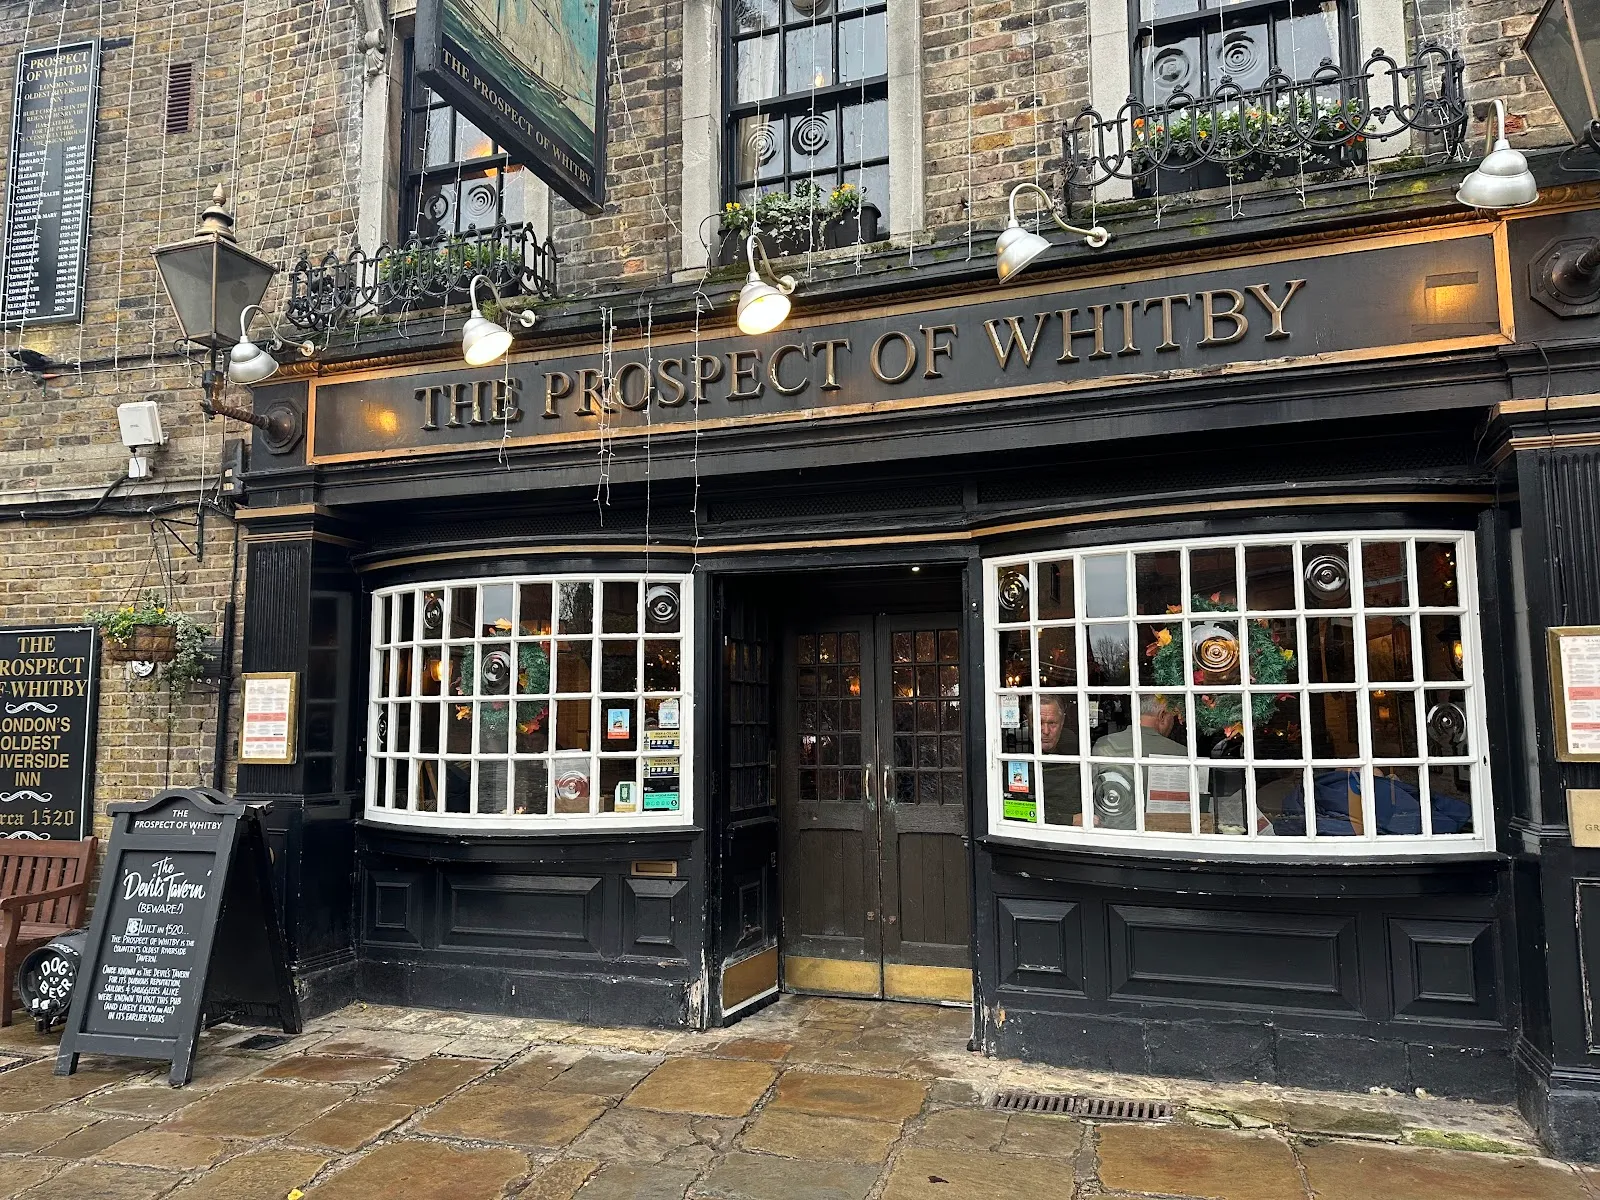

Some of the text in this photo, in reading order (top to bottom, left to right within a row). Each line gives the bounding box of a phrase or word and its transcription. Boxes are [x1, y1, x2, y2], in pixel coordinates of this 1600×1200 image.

[30, 52, 88, 70] PROSPECT
[27, 63, 90, 82] OF WHITBY
[24, 91, 50, 100] OLDEST
[442, 48, 592, 187] THE PROSPECT OF WHITBY
[414, 278, 1308, 432] THE PROSPECT OF WHITBY
[17, 636, 56, 654] THE
[0, 657, 84, 676] ROSPECT
[10, 680, 88, 698] WHITBY
[0, 717, 70, 732] ONDON'S
[0, 736, 61, 750] OLDEST
[15, 772, 40, 786] INN
[31, 808, 75, 826] 1520
[172, 810, 188, 818] THE
[134, 820, 222, 830] PROSPECT OF WHITBY
[152, 856, 174, 876] The
[138, 902, 184, 914] (BEWARE!)
[122, 934, 148, 944] PROSPECT
[114, 945, 140, 953] COUNTRY'S
[160, 948, 186, 956] RIVERSIDE
[41, 957, 69, 976] DOG
[118, 966, 136, 976] KNOWN
[108, 976, 118, 984] FOR
[128, 977, 149, 985] DUBIOUS
[40, 978, 72, 998] BEER
[104, 984, 124, 992] SAILORS
[131, 986, 160, 995] SMUGGLERS
[162, 987, 180, 996] ALIKE
[98, 993, 113, 1001] WERE
[157, 996, 168, 1004] THIS
[170, 997, 182, 1005] PUB
[119, 1003, 138, 1012] LIKELY
[138, 1004, 157, 1012] ENJOY
[108, 1012, 114, 1020] IN
[126, 1013, 147, 1022] EARLIER
[148, 1014, 165, 1023] YEARS
